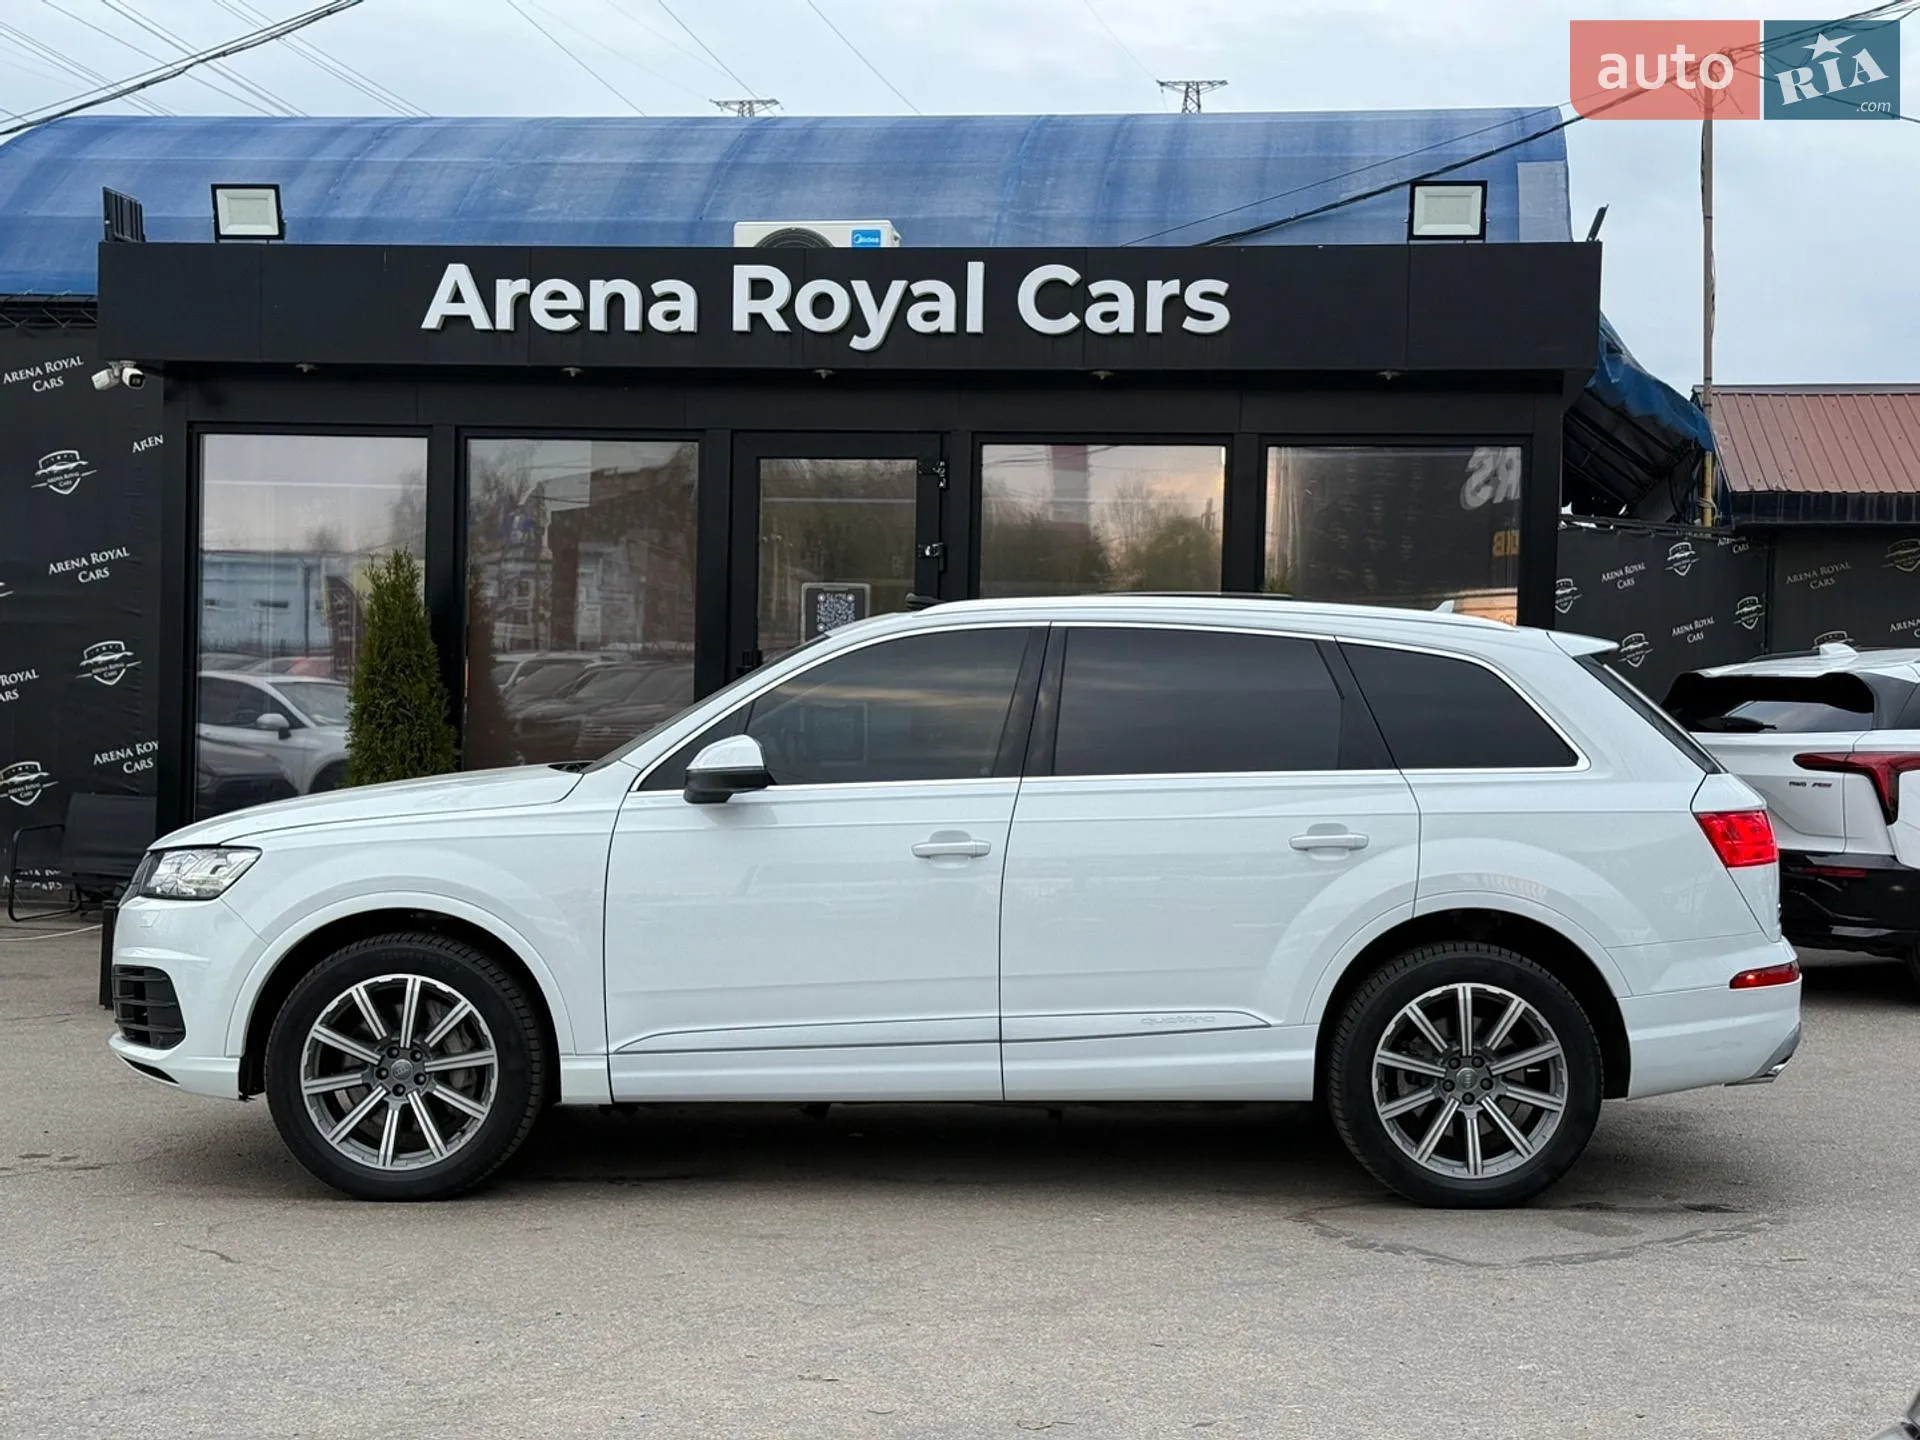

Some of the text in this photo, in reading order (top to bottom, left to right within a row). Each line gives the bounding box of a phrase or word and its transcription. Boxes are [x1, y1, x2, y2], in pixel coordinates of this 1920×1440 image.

[422, 262, 1231, 350] Arena Royal Cars
[3, 355, 84, 384] ARENA ROYAL
[33, 375, 64, 392] CARS
[132, 435, 164, 453] AREN
[48, 546, 130, 575] ARENA ROYAL
[78, 566, 110, 583] CARS
[1601, 562, 1646, 582] ARENA ROYAL
[1786, 561, 1851, 584] ARENA ROYAL
[1616, 577, 1635, 590] CARS
[1809, 577, 1836, 590] CARS
[1672, 616, 1715, 636] ARENA ROYAL
[1686, 630, 1704, 643] CARS
[93, 748, 134, 766] ARENA
[123, 757, 154, 774] CARS
